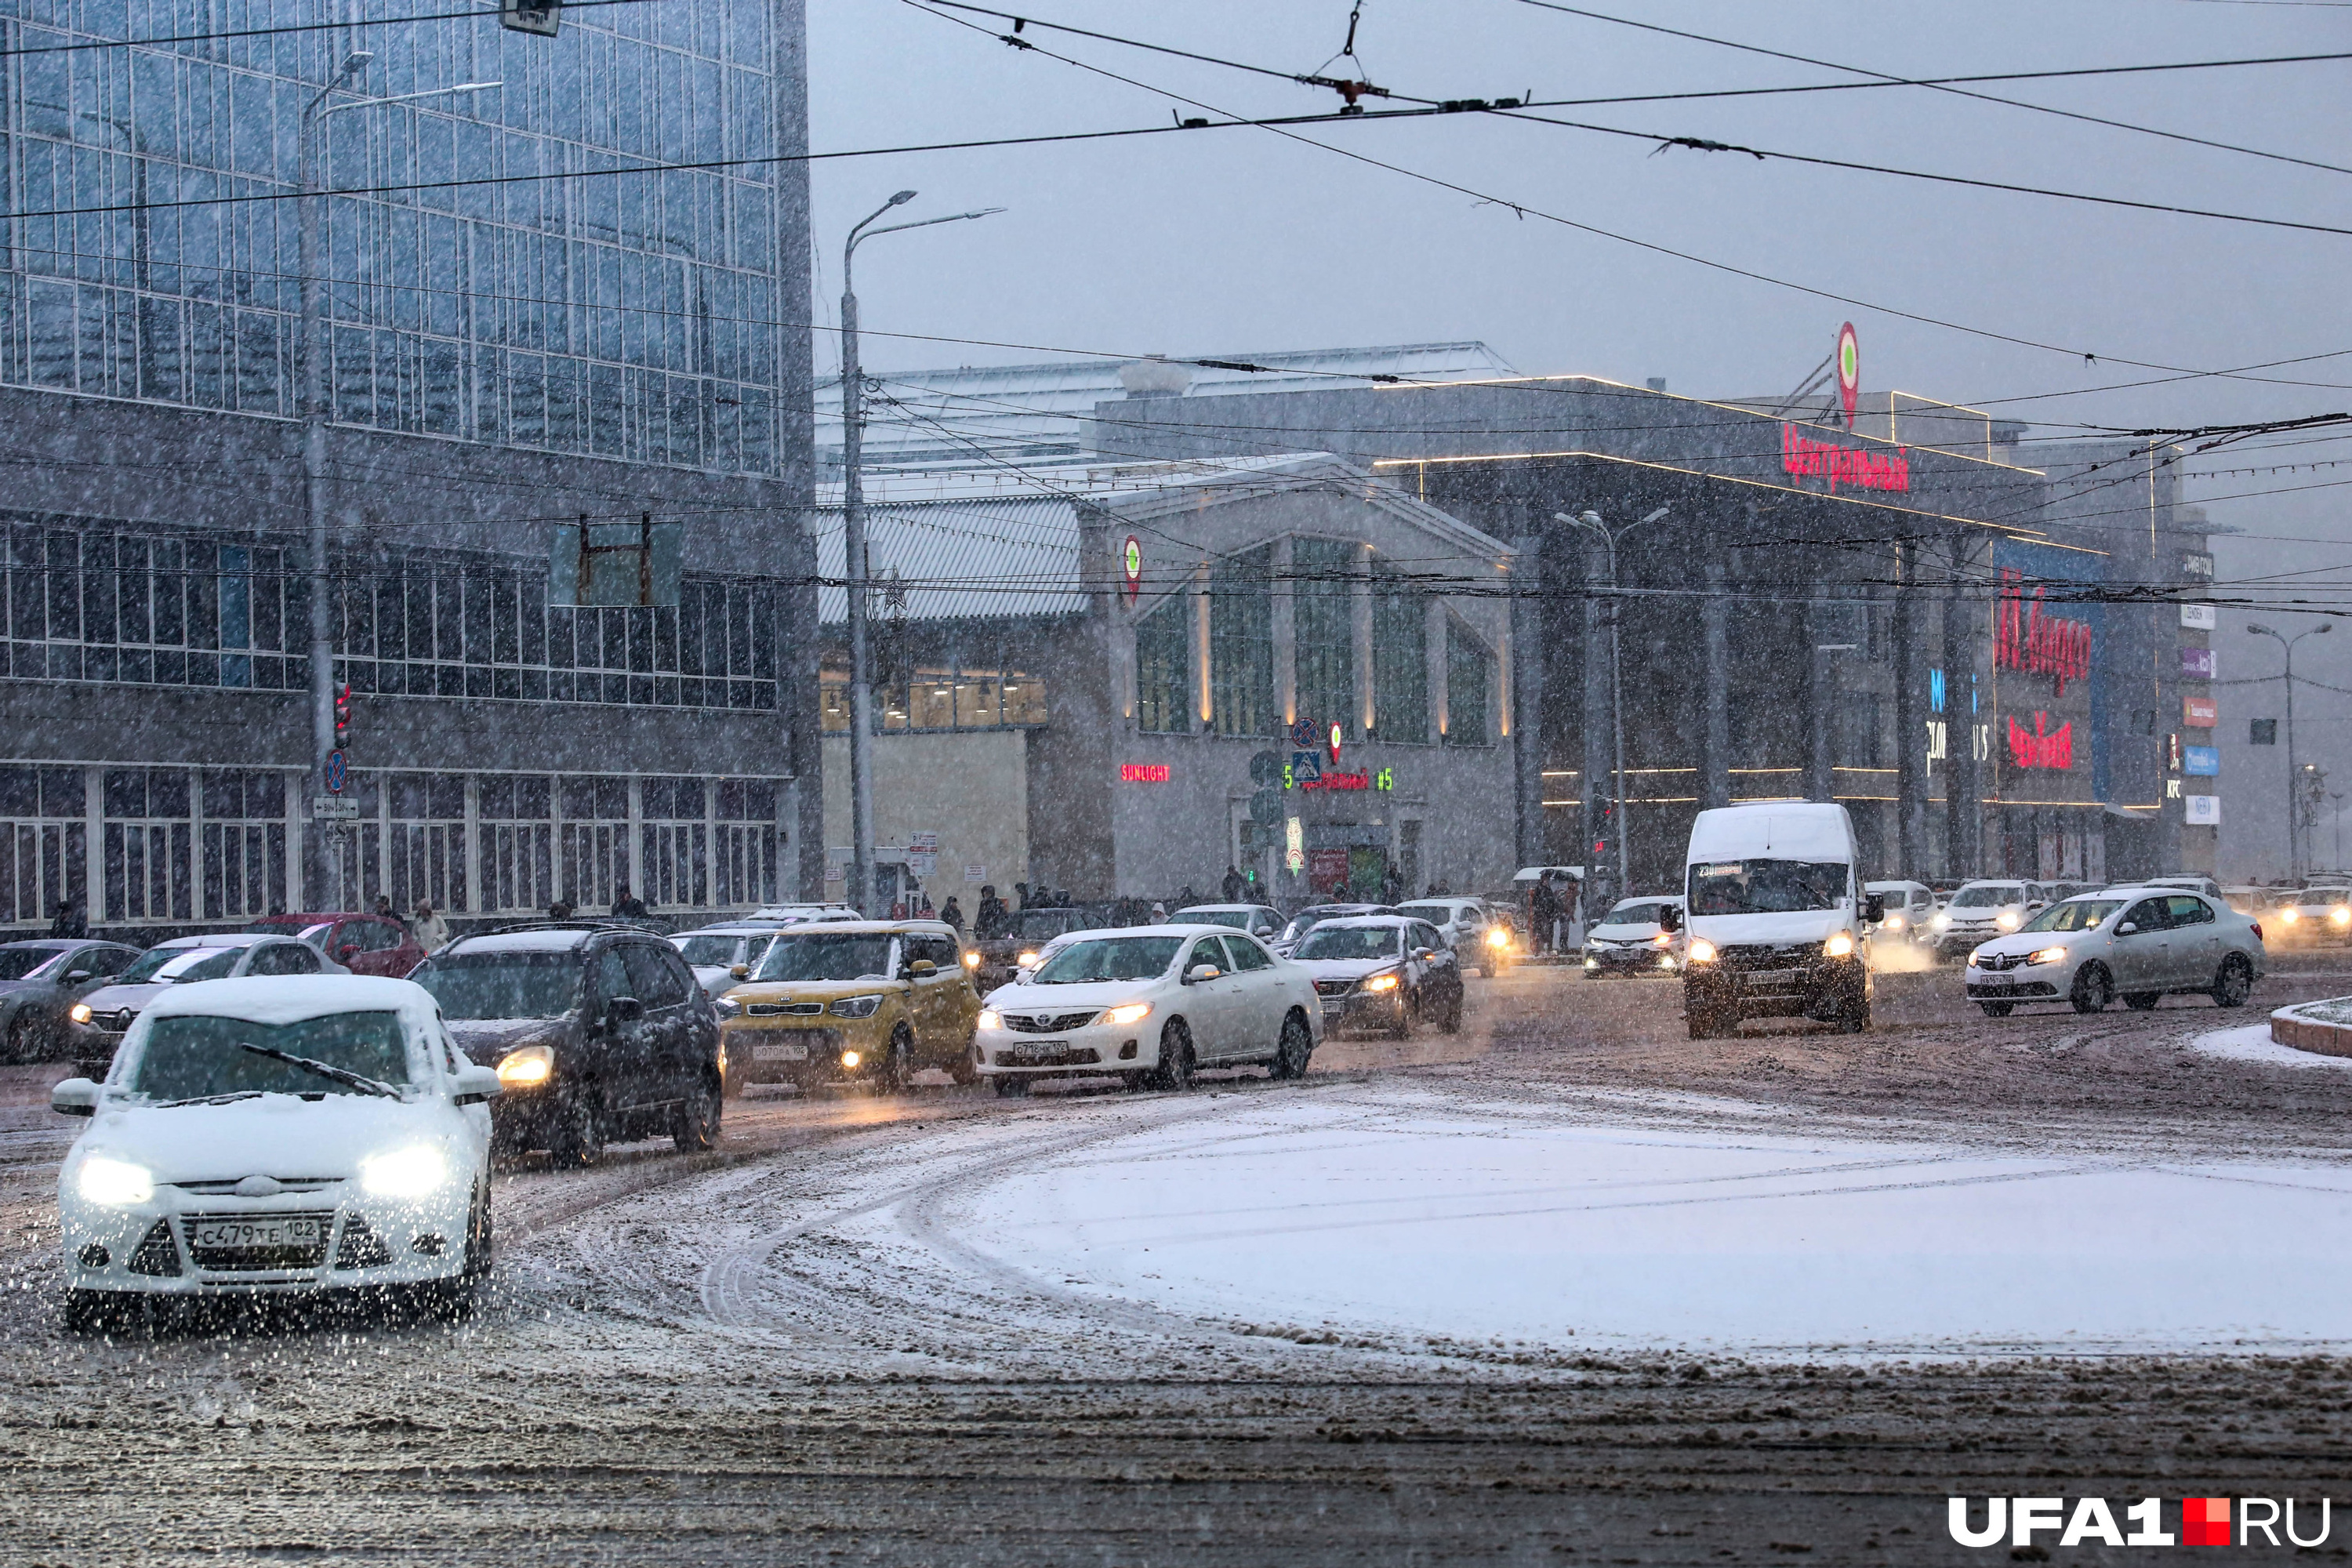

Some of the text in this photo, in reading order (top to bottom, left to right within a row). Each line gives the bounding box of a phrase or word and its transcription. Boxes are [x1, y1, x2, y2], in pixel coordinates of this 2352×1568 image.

[1784, 423, 1909, 495] Центральный
[1121, 764, 1170, 782] SUNLIGHT
[1377, 768, 1393, 791] #5
[2166, 779, 2181, 799] KFC
[285, 1221, 314, 1236] 102
